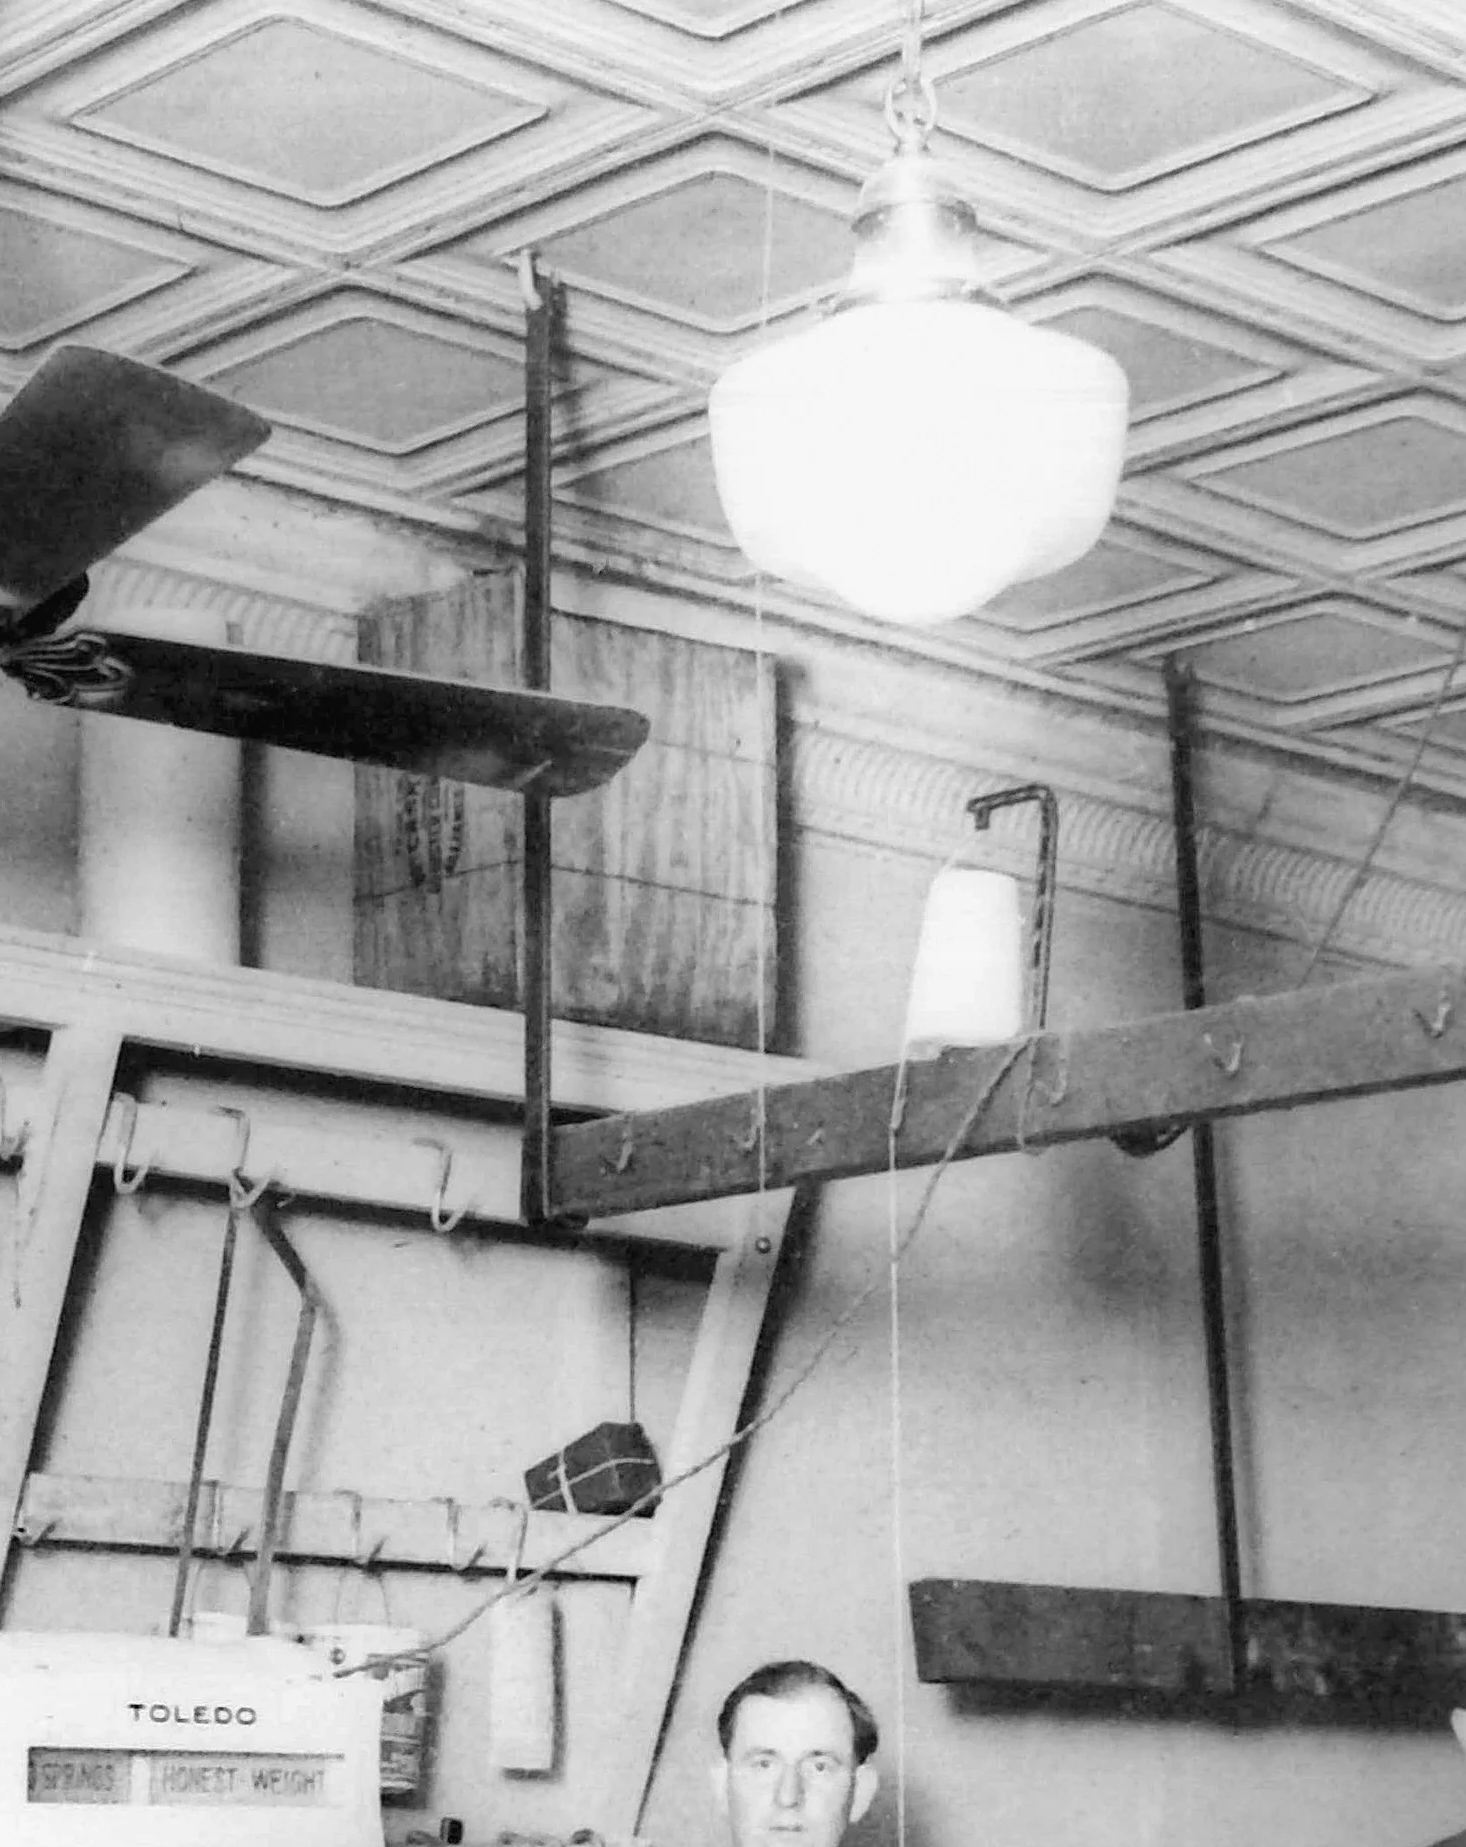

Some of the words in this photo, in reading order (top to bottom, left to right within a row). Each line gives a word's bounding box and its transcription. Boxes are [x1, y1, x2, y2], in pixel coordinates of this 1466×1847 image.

[128, 1703, 257, 1725] TOLEDO
[162, 1765, 238, 1794] HONEST
[252, 1767, 327, 1797] WEIGHT
